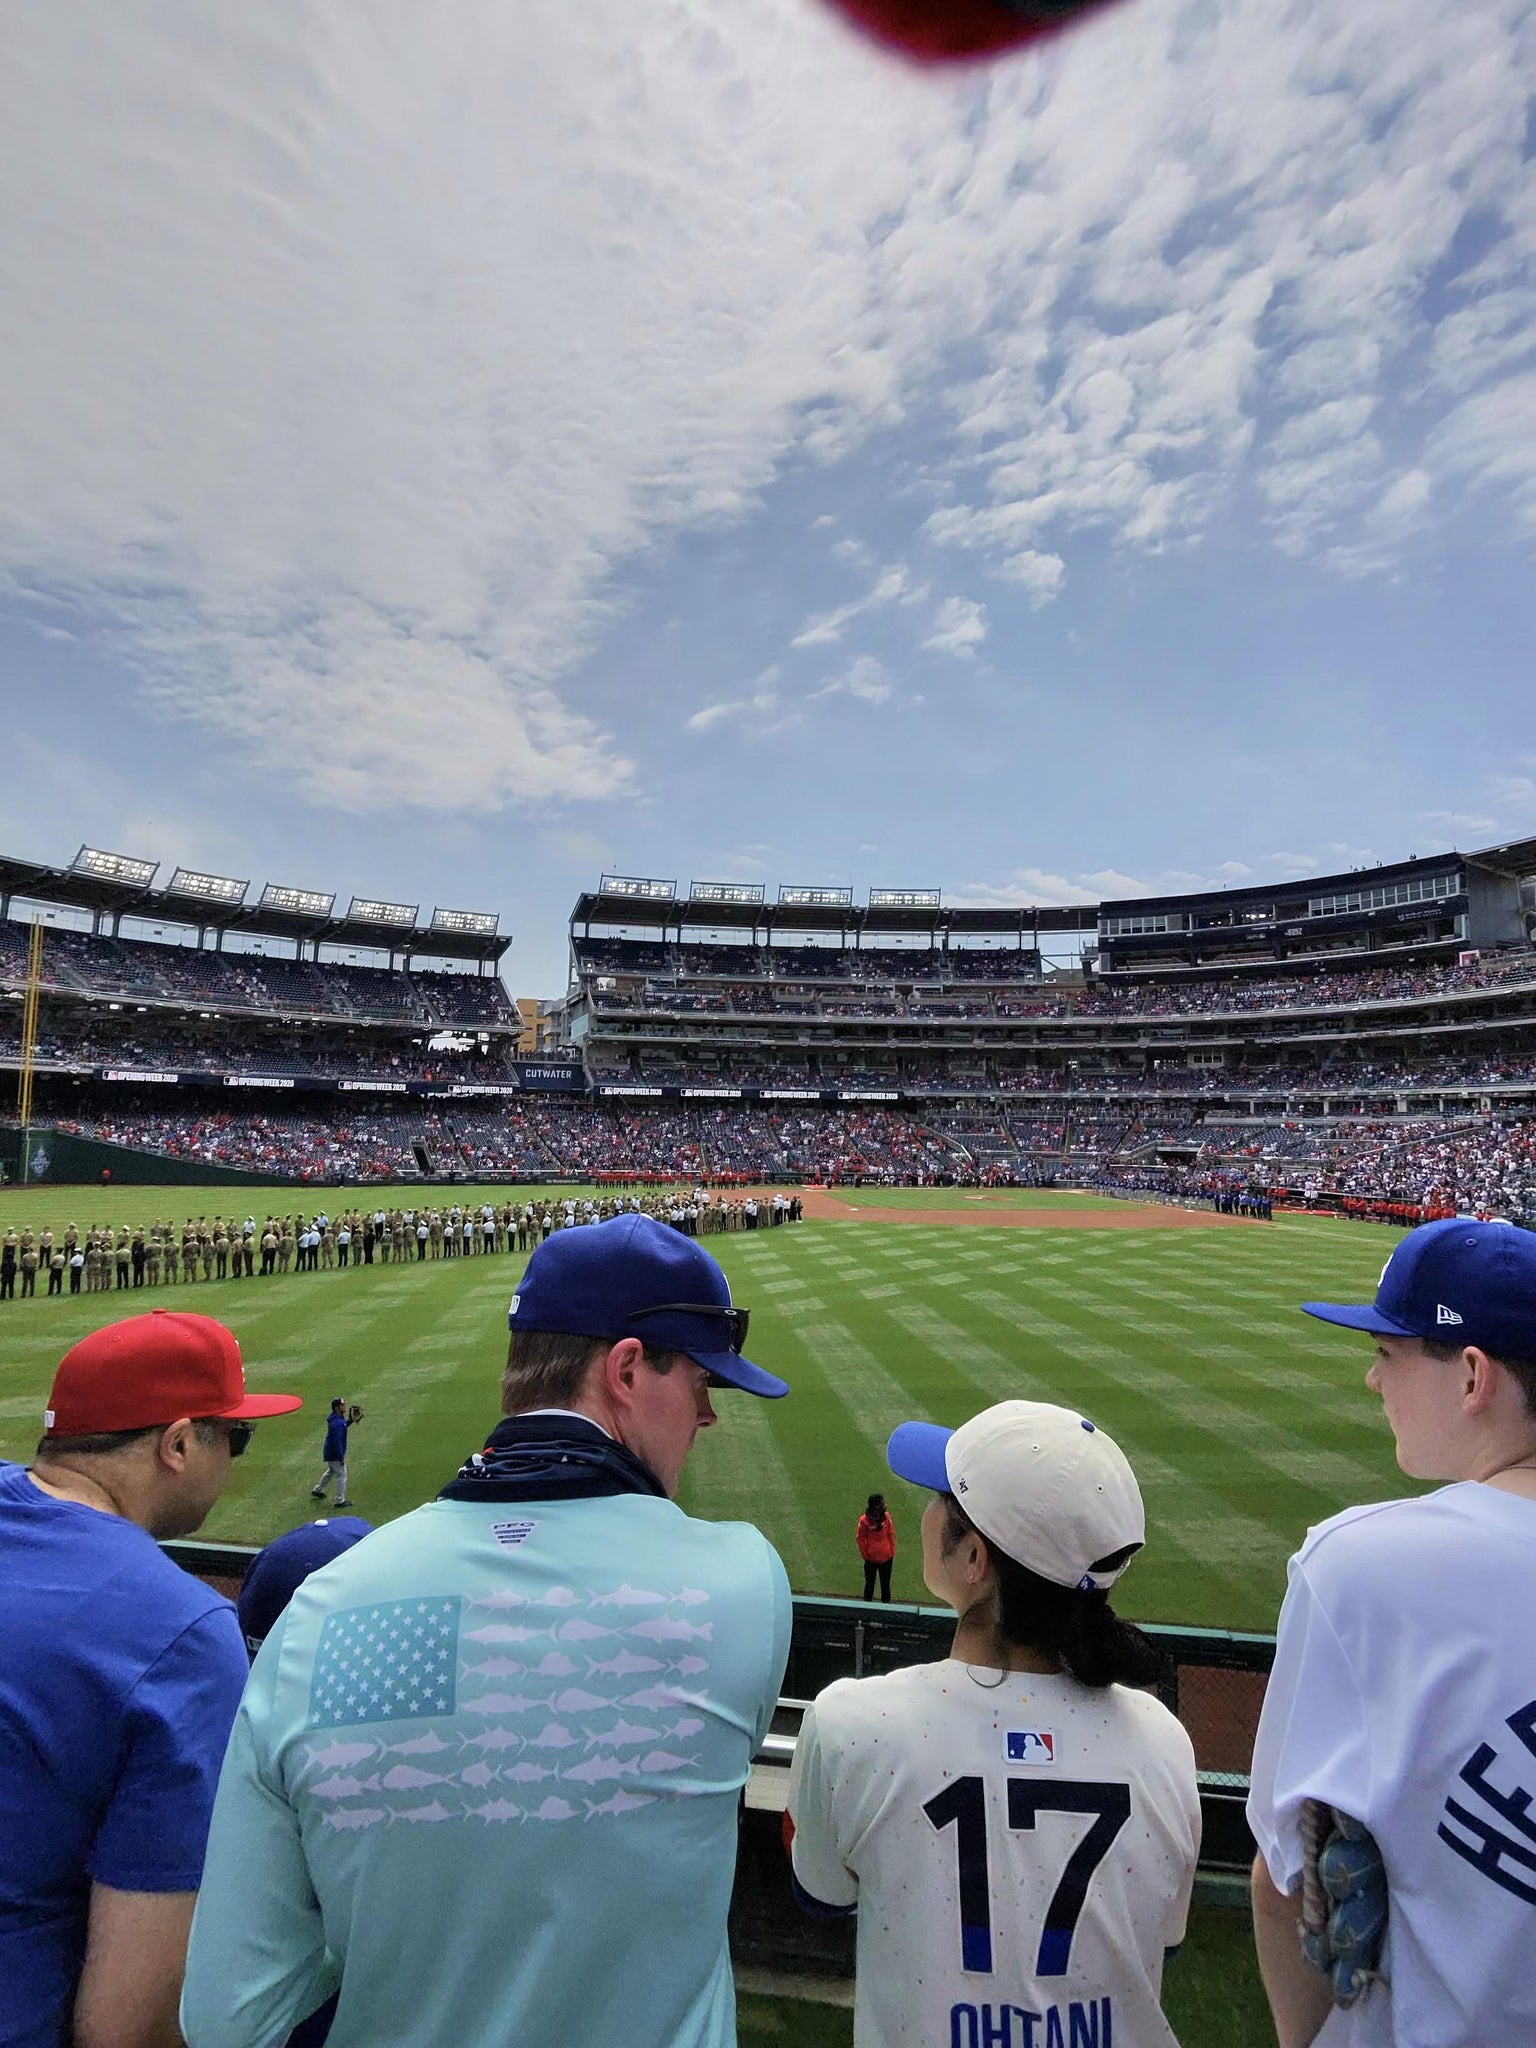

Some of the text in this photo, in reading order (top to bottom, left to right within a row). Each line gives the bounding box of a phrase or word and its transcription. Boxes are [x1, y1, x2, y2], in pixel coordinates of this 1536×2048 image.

[118, 1071, 145, 1081] OPENING
[146, 1072, 163, 1082] WEEK
[525, 1069, 572, 1079] CUTWATER
[239, 1077, 264, 1086] OPENING
[264, 1078, 280, 1087] WEEK
[352, 1082, 377, 1090] OPENING
[377, 1083, 392, 1091] WEEK
[462, 1085, 485, 1093] OPENING
[485, 1086, 500, 1094] WEEK
[922, 1775, 1131, 1977] 17
[950, 1997, 1112, 2048] OHTANI
